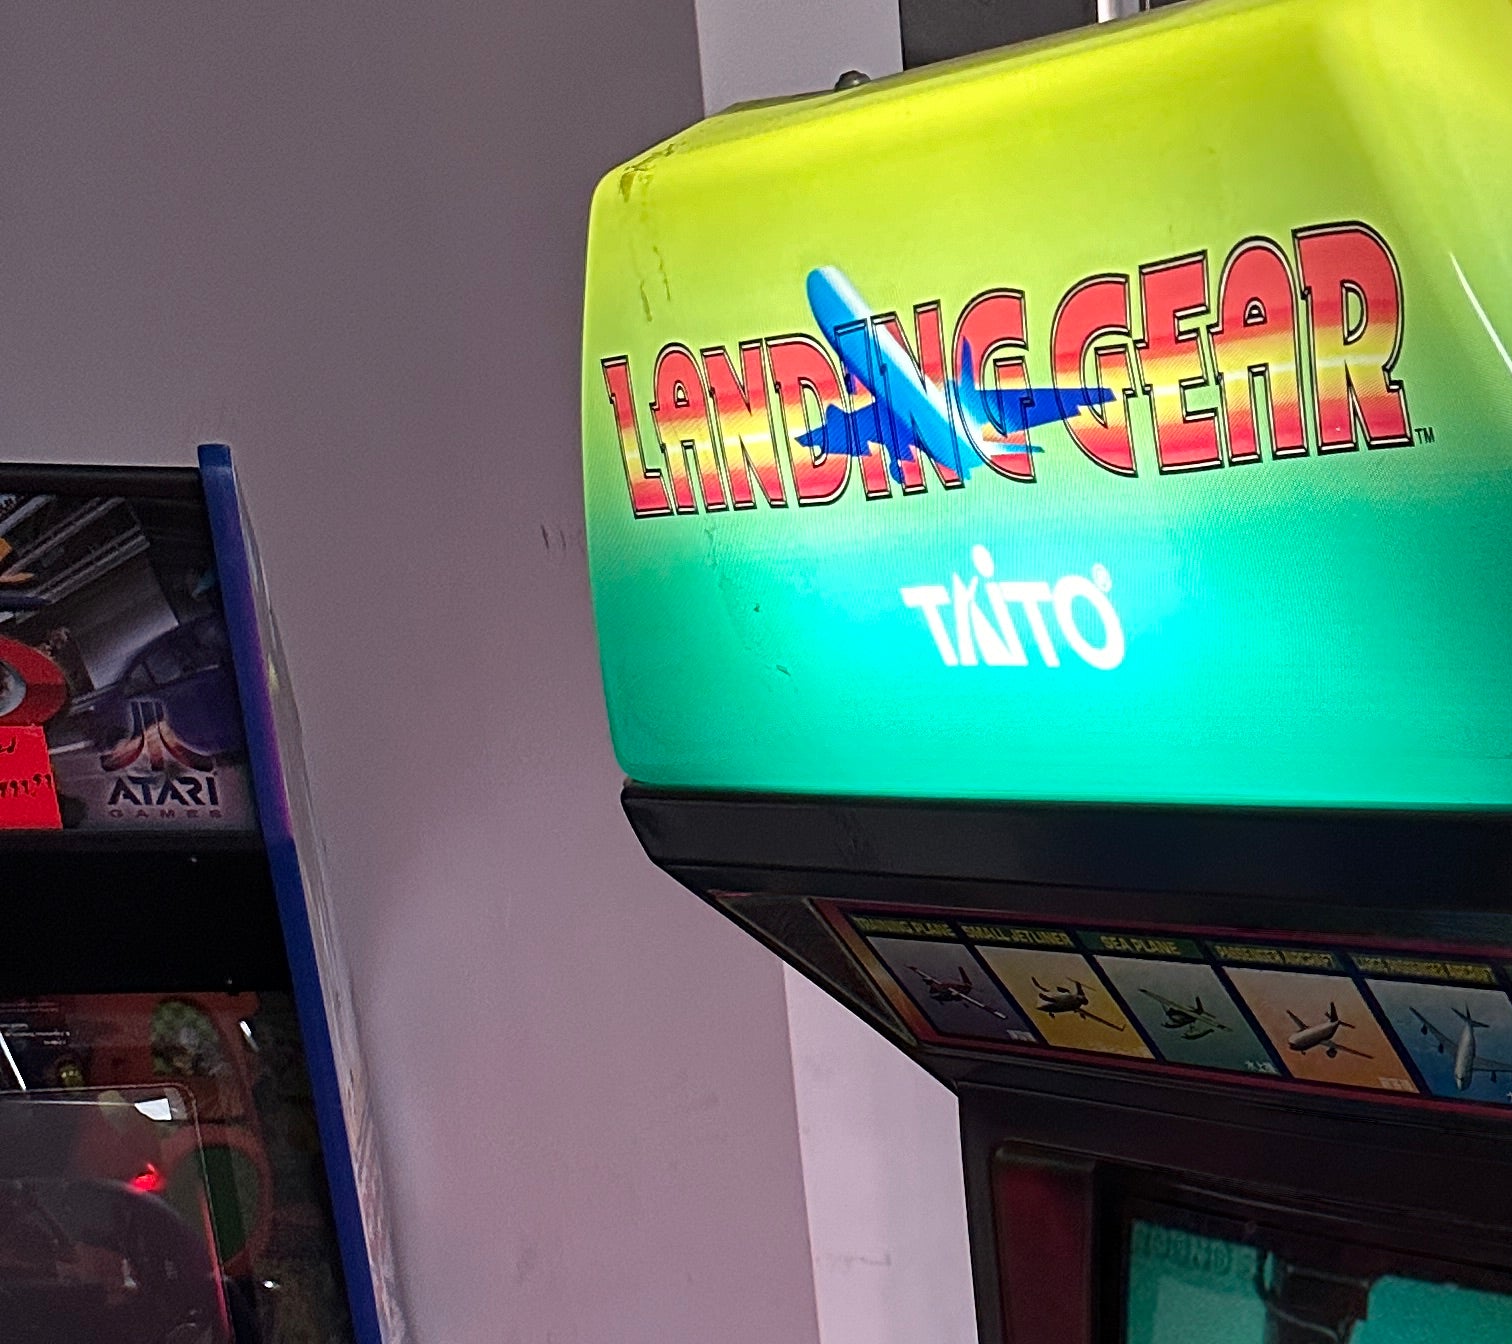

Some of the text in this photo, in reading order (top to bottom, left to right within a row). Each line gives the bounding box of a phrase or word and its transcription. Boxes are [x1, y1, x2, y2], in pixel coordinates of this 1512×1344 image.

[600, 289, 1037, 519] LANDING
[1051, 220, 1415, 477] GEAR
[900, 545, 1126, 670] TAITO
[108, 776, 219, 806] ATARI
[109, 810, 222, 818] GAMES
[961, 925, 1006, 942] SMALL
[1100, 935, 1182, 956] SEA PLANE
